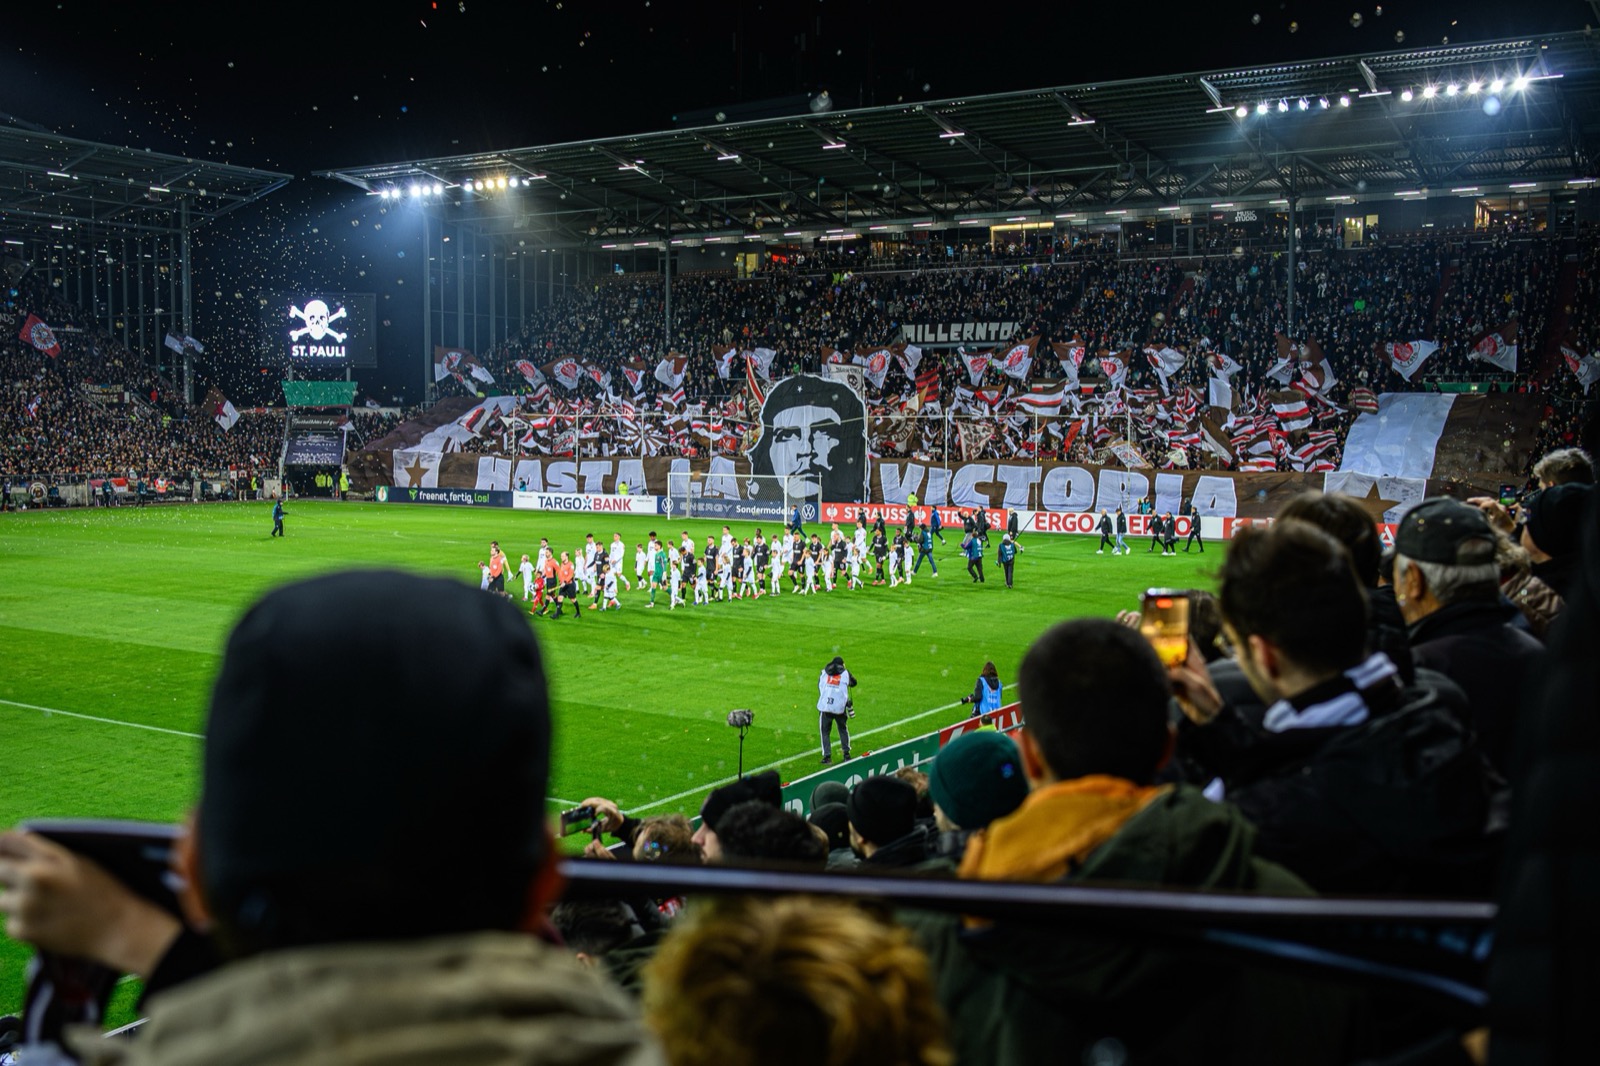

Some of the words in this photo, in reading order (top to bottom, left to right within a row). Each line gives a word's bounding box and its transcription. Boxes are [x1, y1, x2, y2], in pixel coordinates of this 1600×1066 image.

[1234, 215, 1258, 223] STUDIO
[292, 345, 308, 357] ST.
[309, 345, 346, 357] PAULI
[475, 456, 647, 495] HASTA
[670, 456, 740, 500] LA
[879, 463, 1238, 518] VICTORIA
[474, 493, 490, 503] los!
[938, 507, 1002, 525] STRSS
[1035, 512, 1095, 533] ERGO
